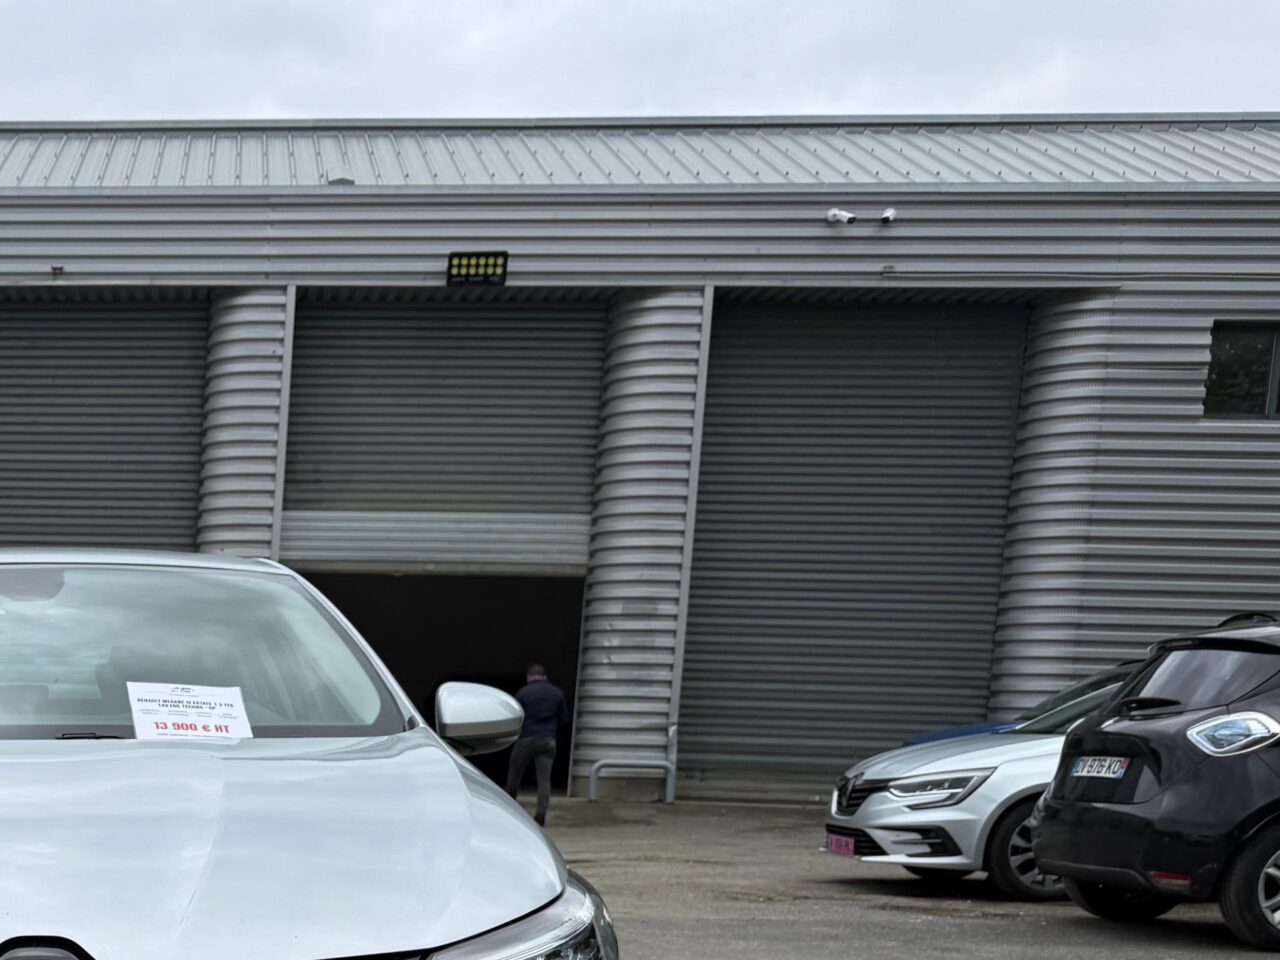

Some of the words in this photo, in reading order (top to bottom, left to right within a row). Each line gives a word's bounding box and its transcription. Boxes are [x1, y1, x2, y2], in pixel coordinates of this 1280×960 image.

[154, 721, 168, 730] 13
[172, 722, 198, 731] 900
[201, 724, 211, 732] €
[214, 724, 230, 733] HT
